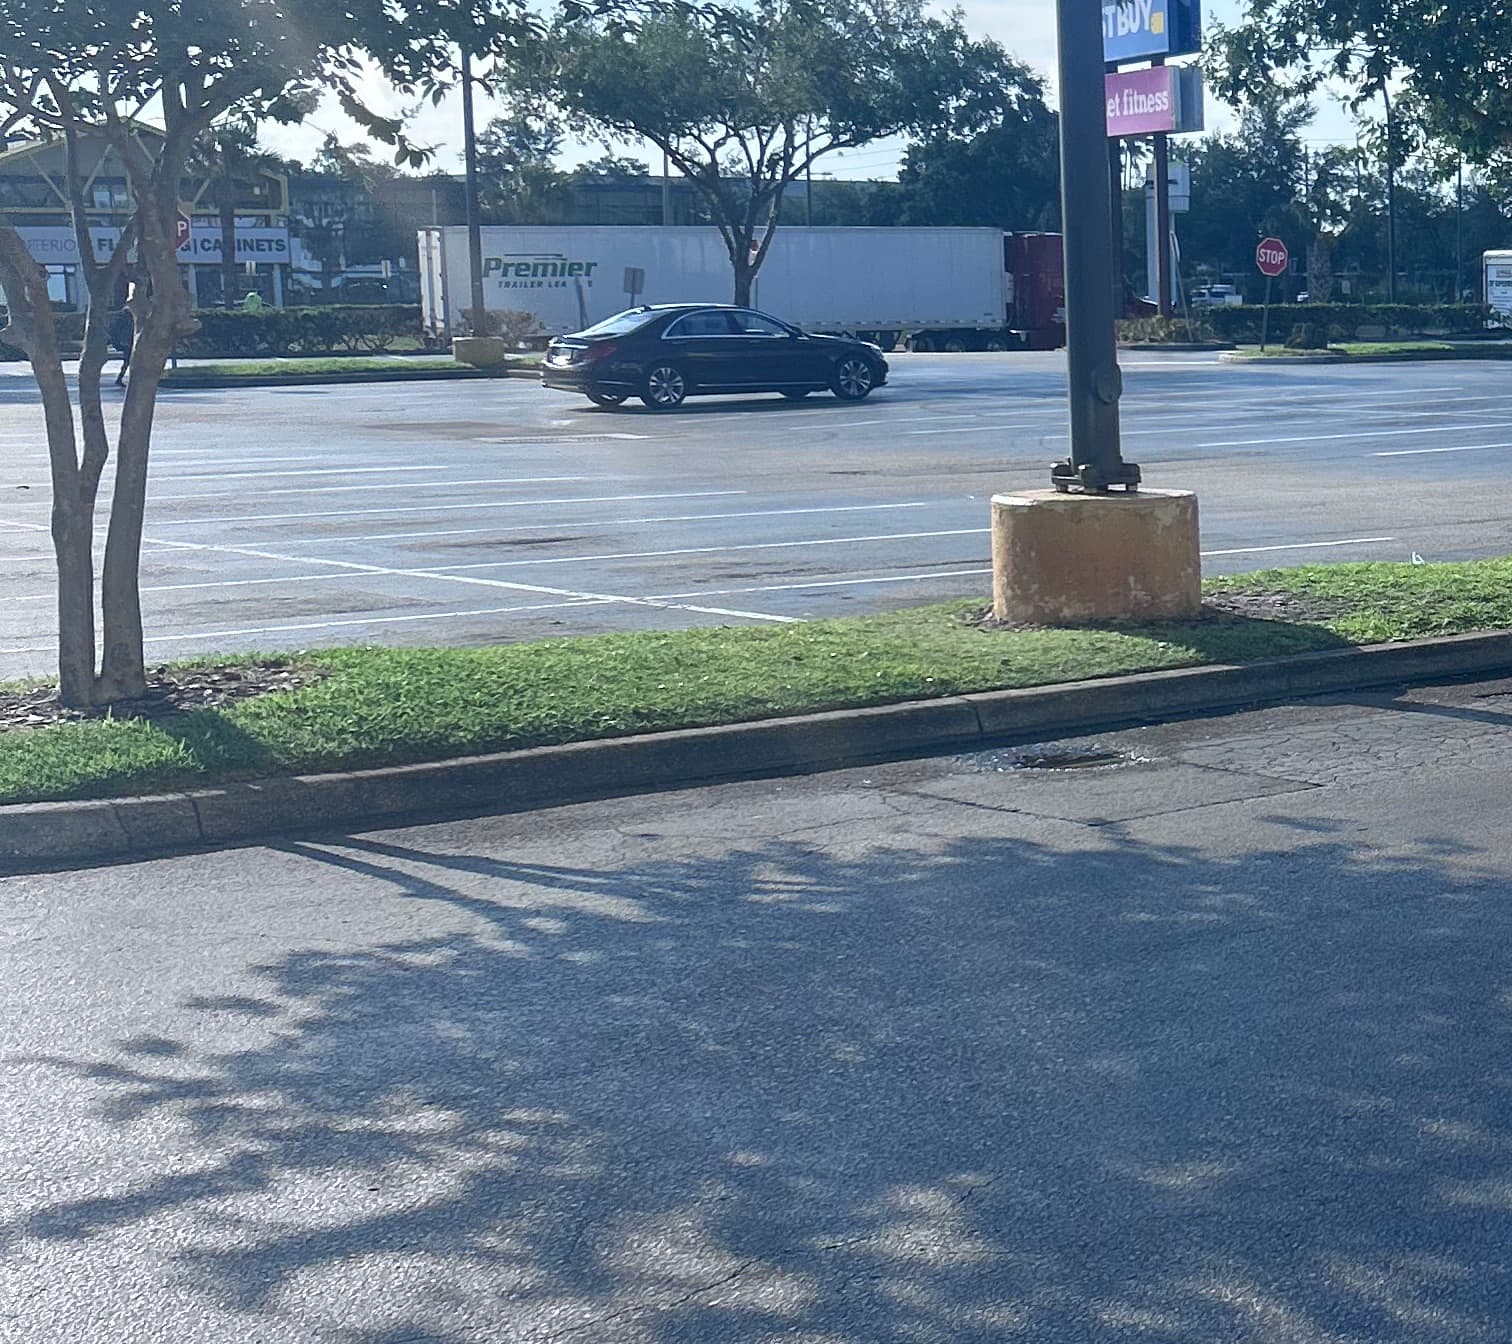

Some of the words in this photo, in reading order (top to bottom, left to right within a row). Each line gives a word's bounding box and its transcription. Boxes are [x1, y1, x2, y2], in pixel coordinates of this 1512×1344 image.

[1123, 88, 1168, 115] fitness
[200, 238, 286, 252] CAINETS
[1259, 248, 1285, 264] STOP
[482, 257, 597, 277] Premier
